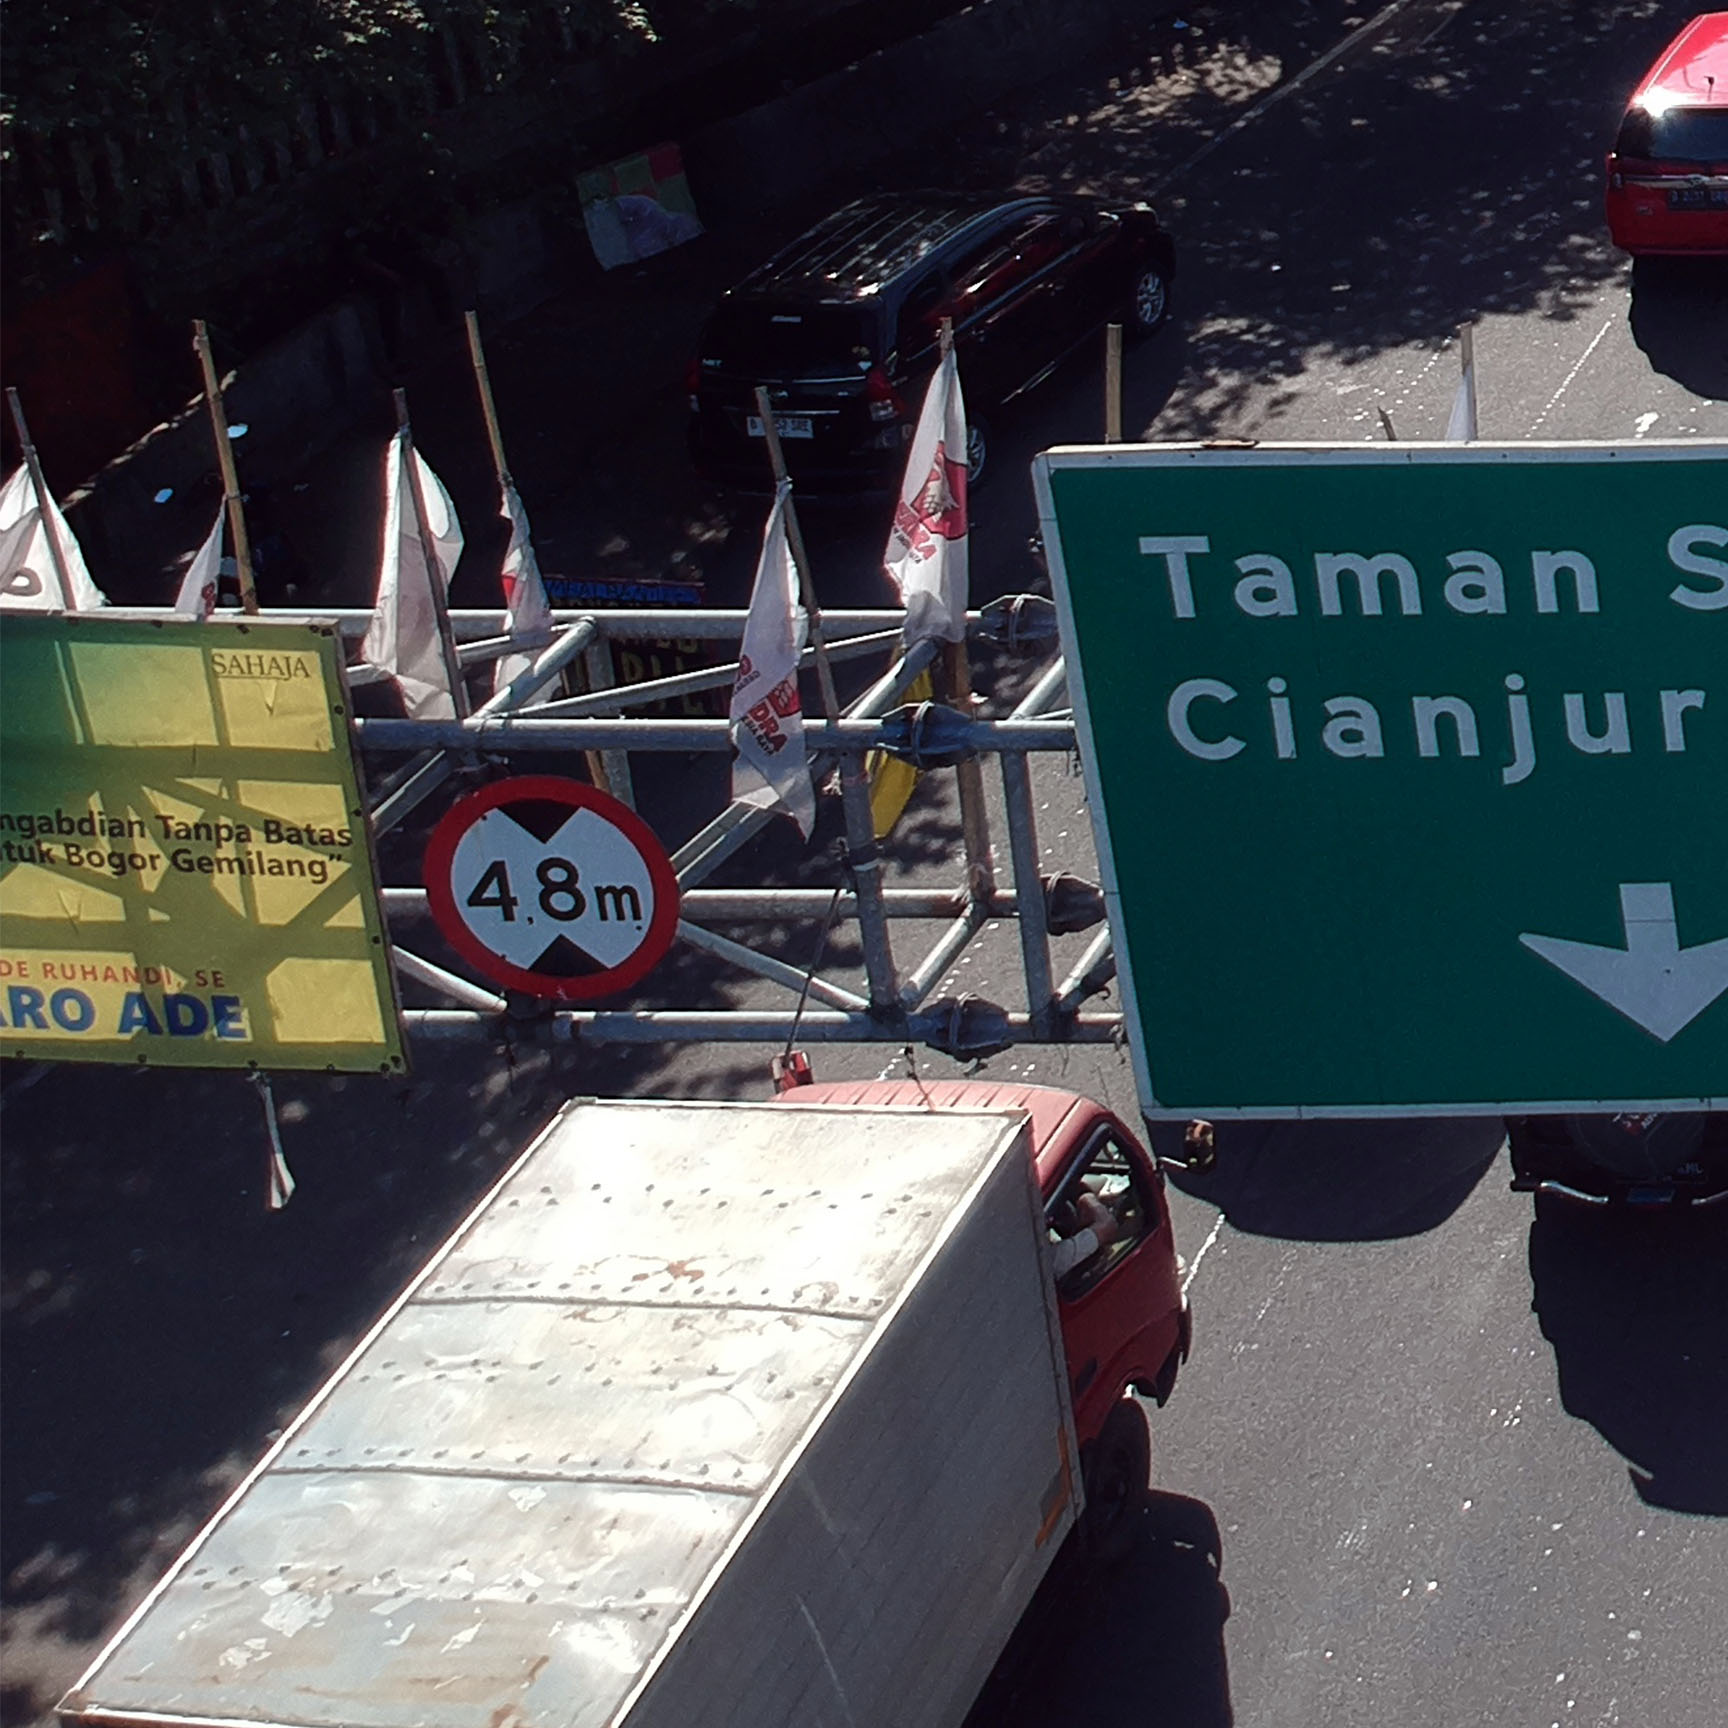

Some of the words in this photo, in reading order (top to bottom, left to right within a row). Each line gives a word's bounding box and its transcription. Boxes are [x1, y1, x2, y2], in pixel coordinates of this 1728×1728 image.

[1138, 534, 1600, 619] Taman
[211, 653, 312, 680] SAHAJA
[1167, 672, 1706, 785] Cianjur
[154, 814, 252, 847] Tanpa
[263, 820, 353, 848] Batas
[64, 843, 161, 876] Bogor
[43, 962, 184, 989] RUHANDI,
[195, 970, 226, 988] SE
[0, 985, 96, 1033] RO
[118, 991, 248, 1039] ADE
